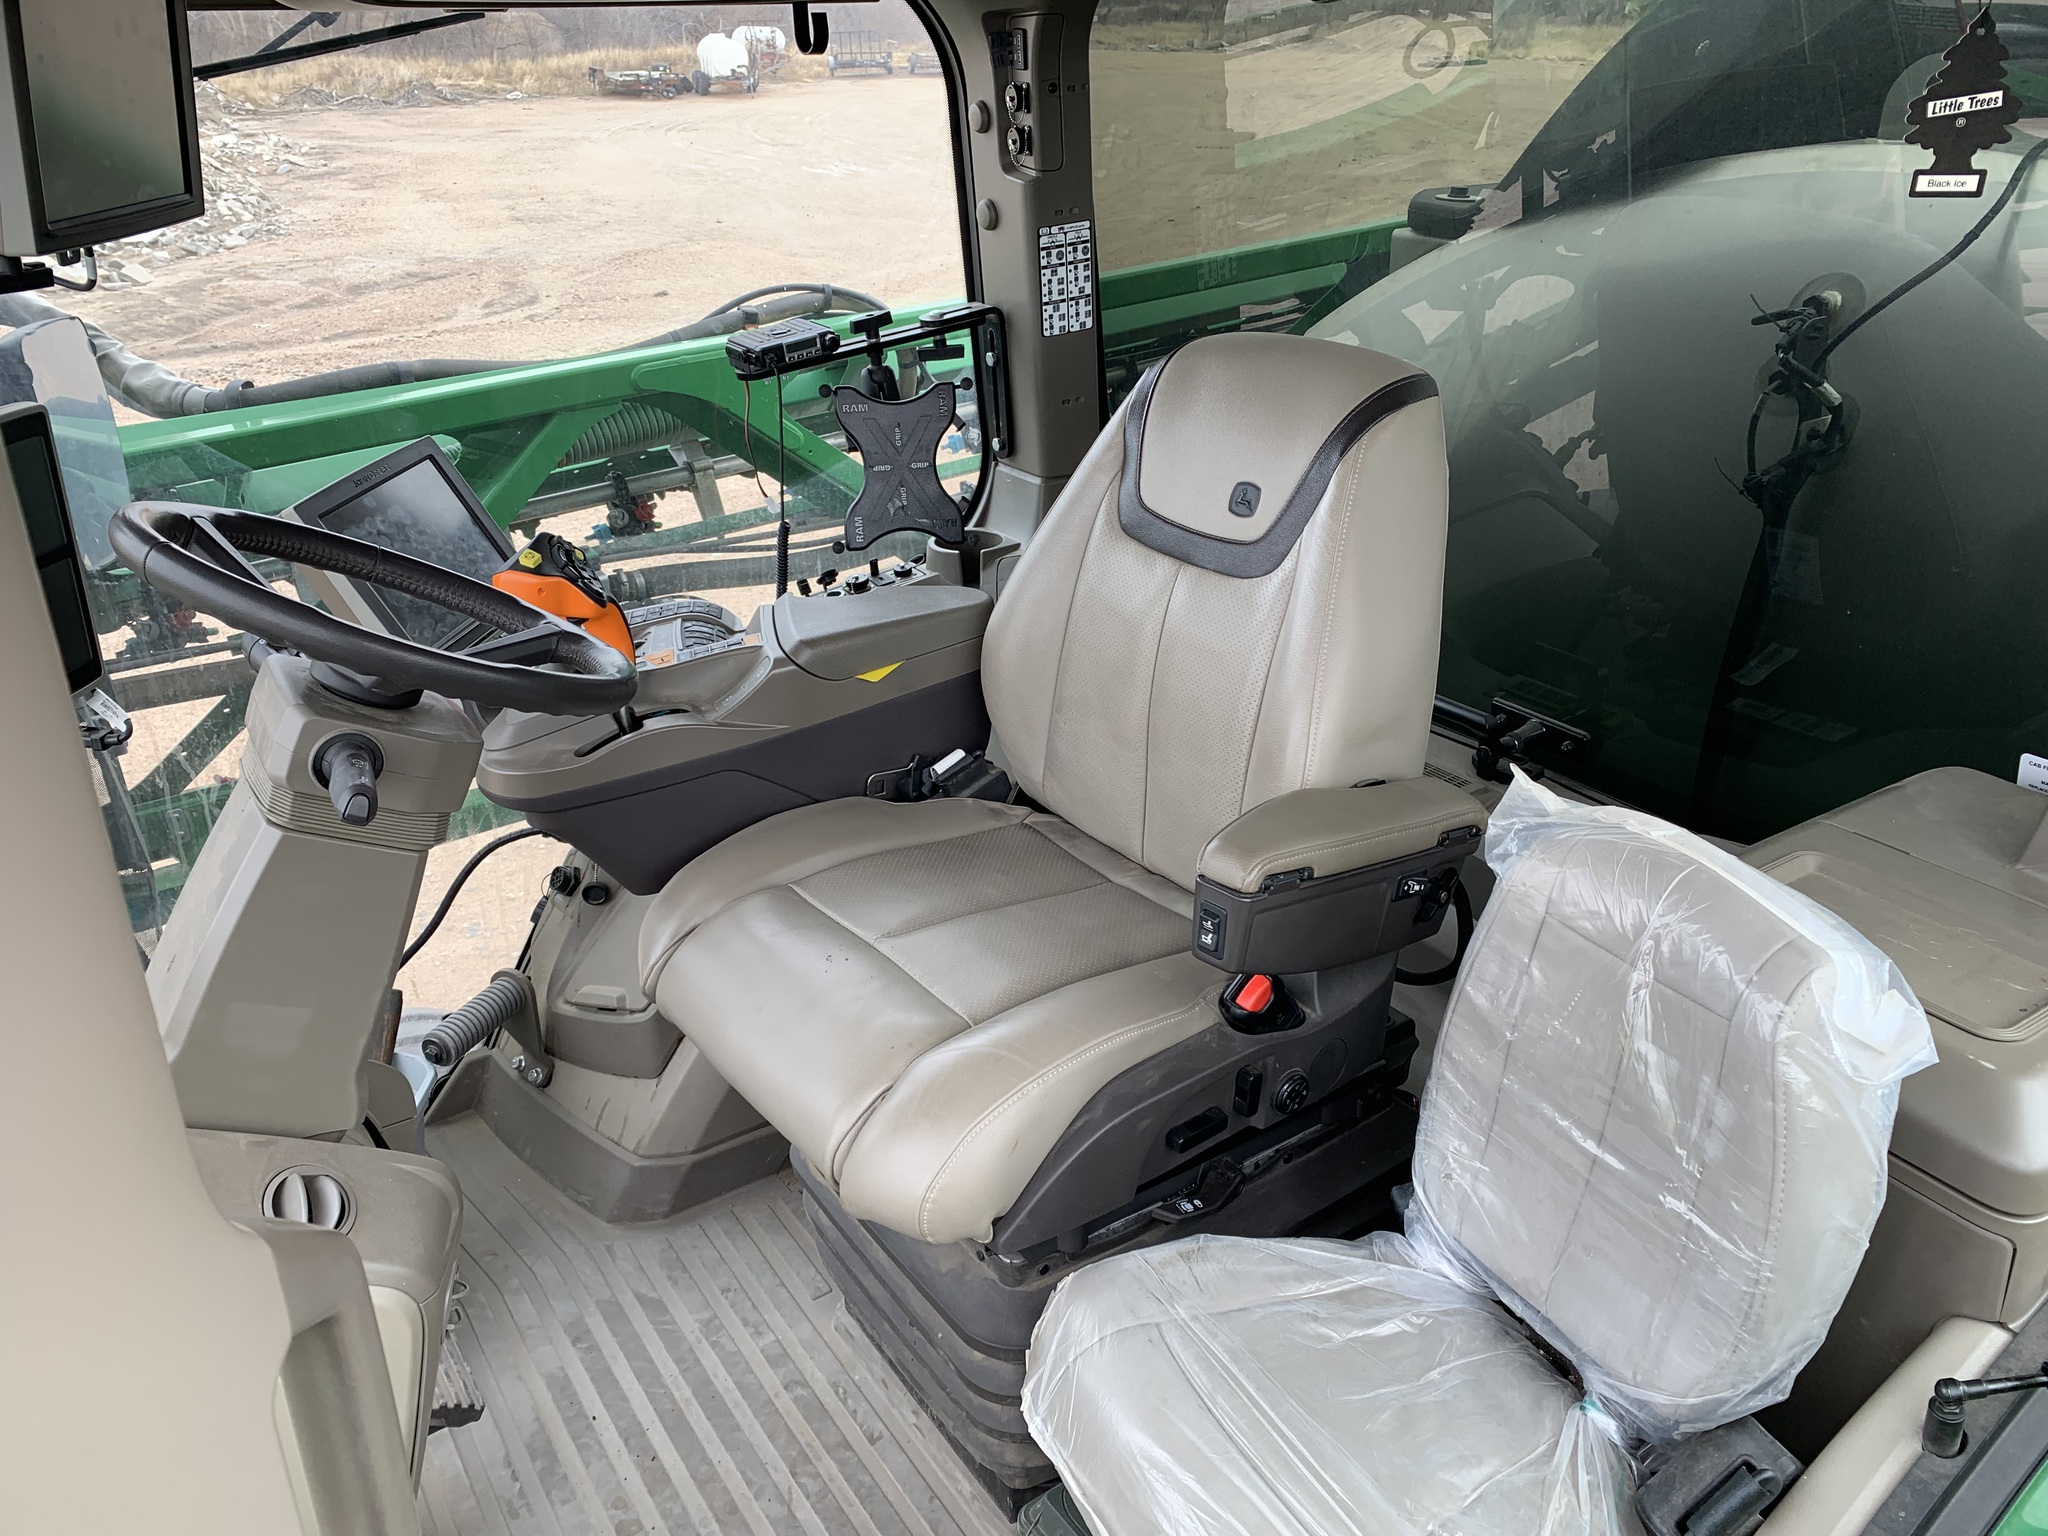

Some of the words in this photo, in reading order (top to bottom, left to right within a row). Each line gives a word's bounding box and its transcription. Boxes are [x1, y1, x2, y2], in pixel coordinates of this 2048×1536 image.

[1932, 99, 1964, 115] Little
[1968, 96, 2000, 110] Trees
[1927, 179, 1951, 188] Black
[1953, 179, 1967, 188] Ice
[843, 404, 869, 413] RAM
[938, 390, 948, 417] RAM
[855, 516, 865, 542] RAM
[2028, 760, 2042, 768] CAB
